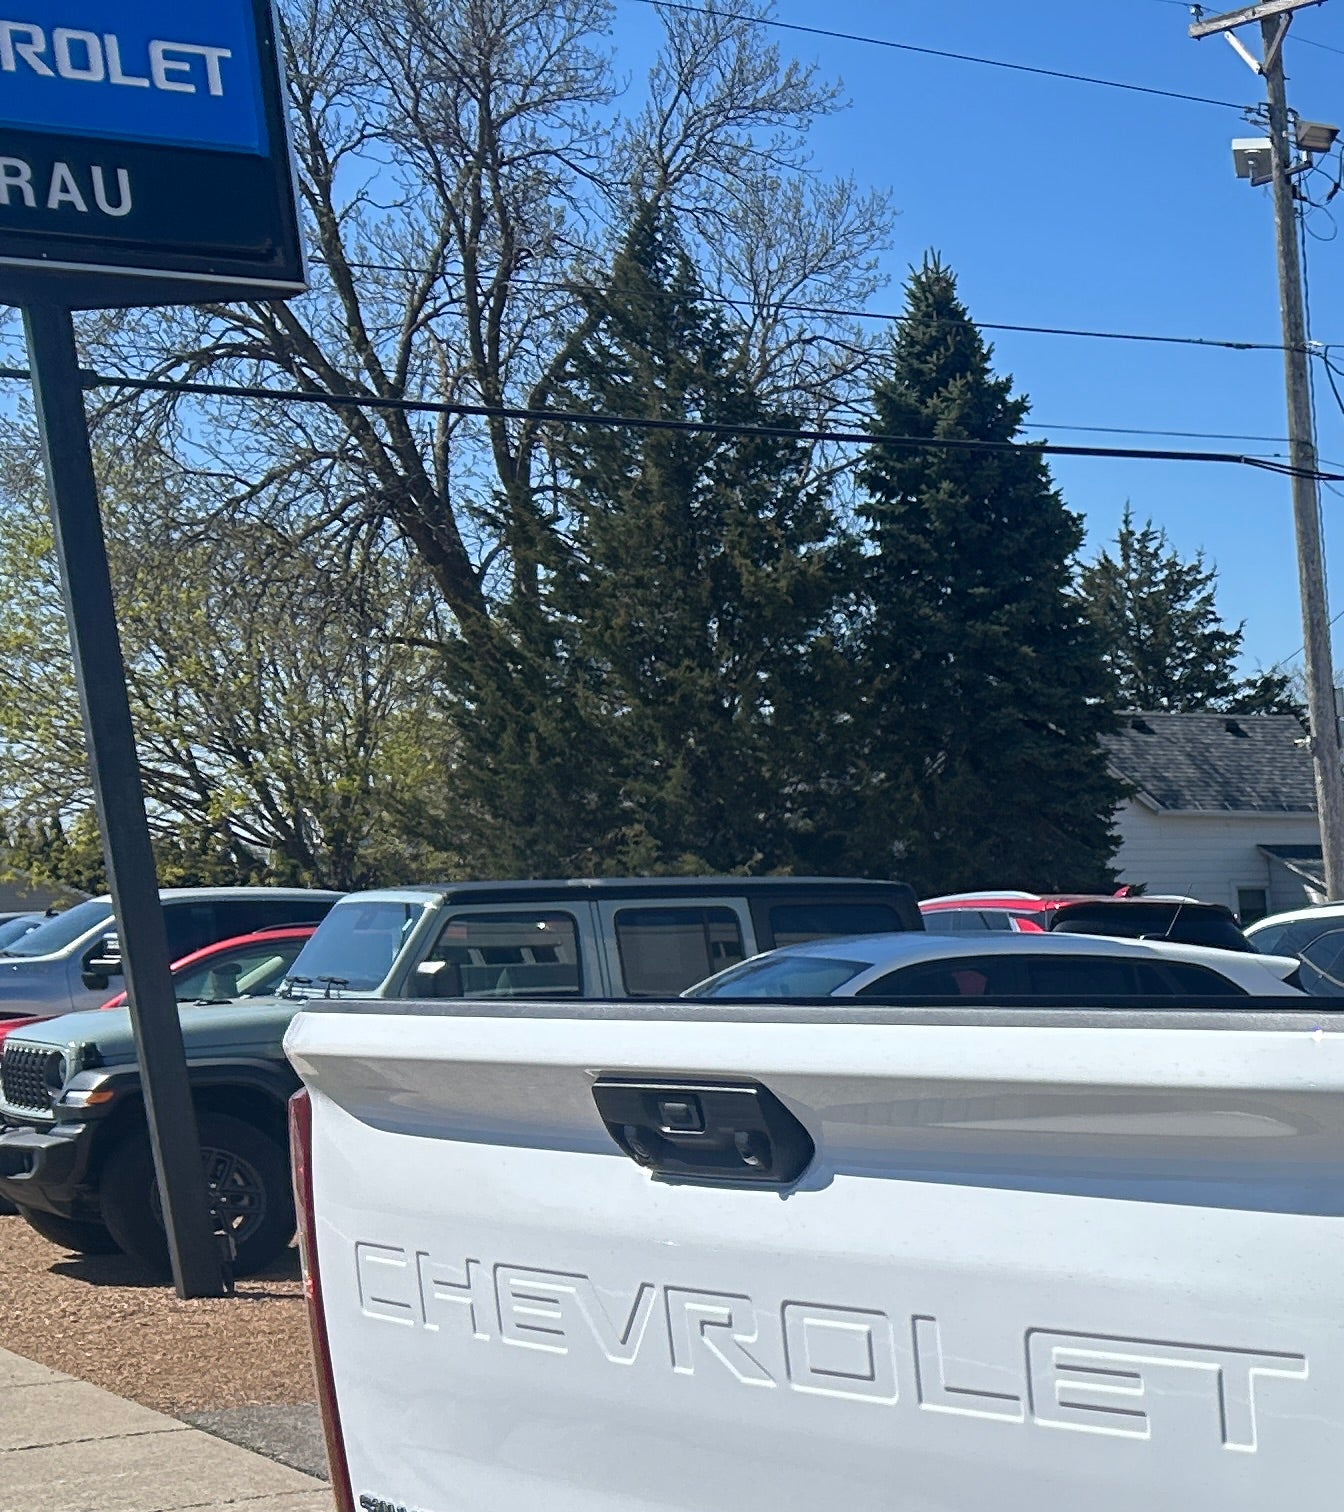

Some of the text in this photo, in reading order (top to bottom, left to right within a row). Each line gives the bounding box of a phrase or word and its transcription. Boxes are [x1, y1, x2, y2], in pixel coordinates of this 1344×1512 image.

[0, 20, 232, 96] ROLET
[0, 156, 133, 217] RAU
[354, 1240, 1309, 1453] CHEVROLET
